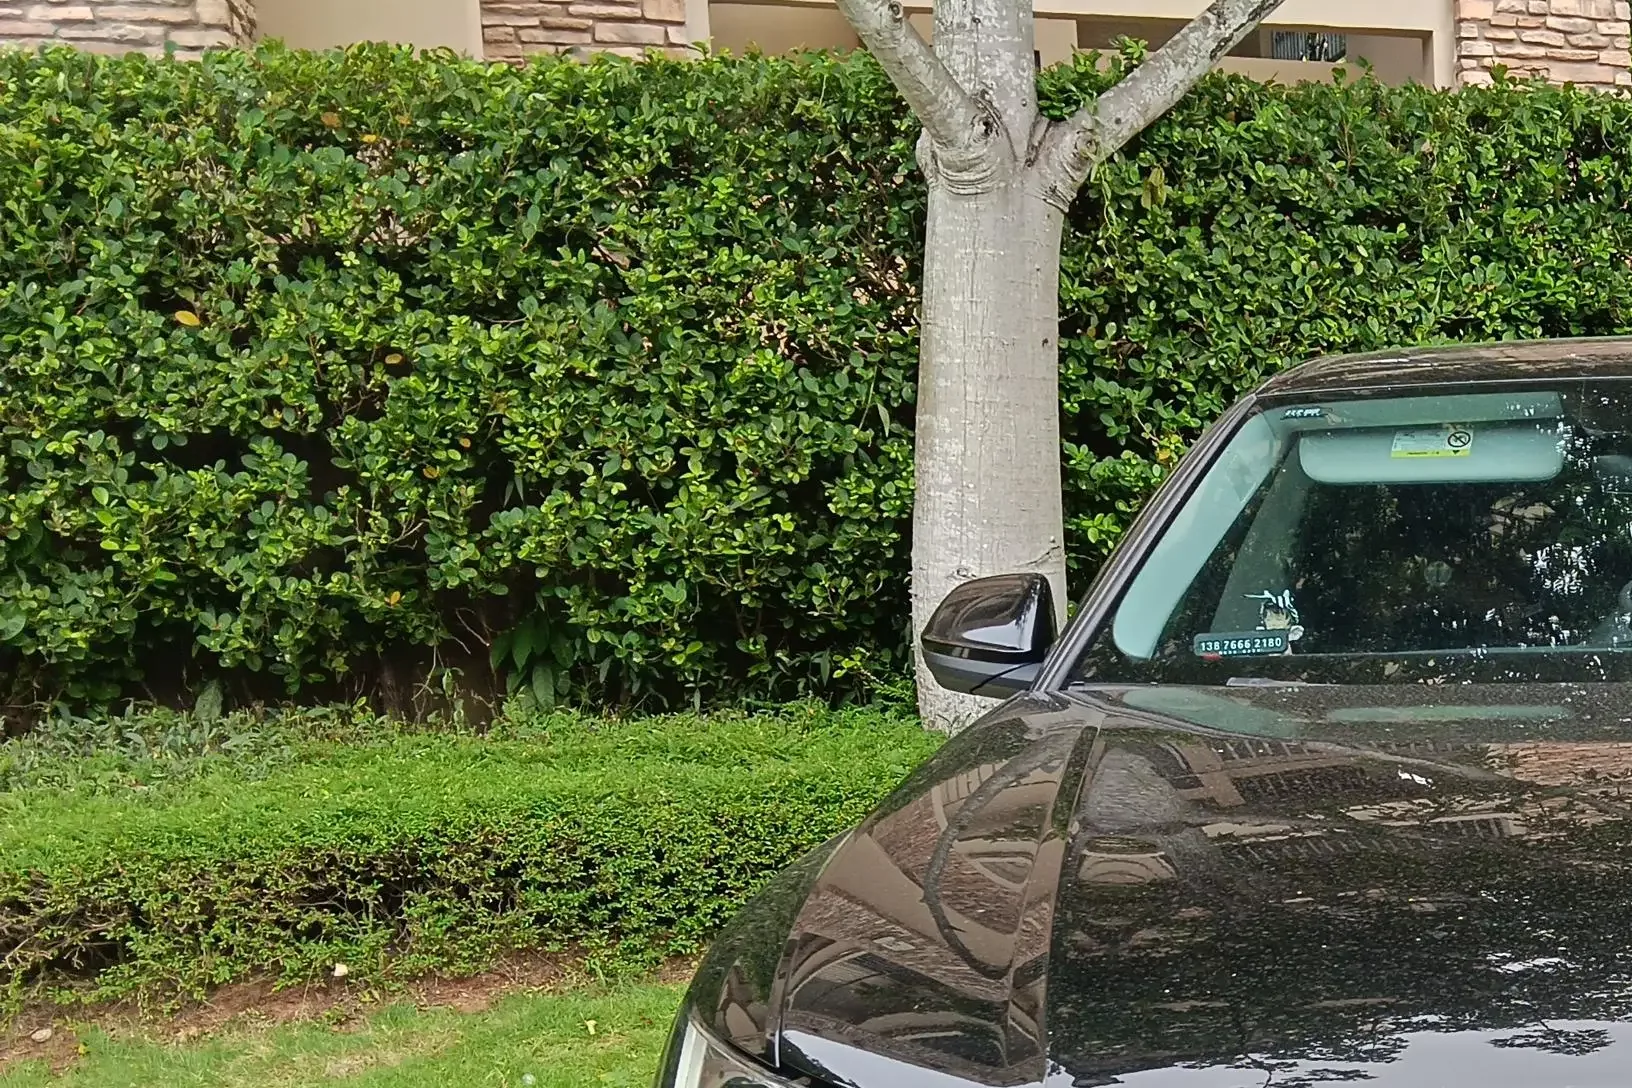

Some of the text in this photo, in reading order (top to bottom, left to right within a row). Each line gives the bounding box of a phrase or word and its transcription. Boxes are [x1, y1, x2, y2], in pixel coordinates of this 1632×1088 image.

[1200, 637, 1282, 651] 138 7666 2180
